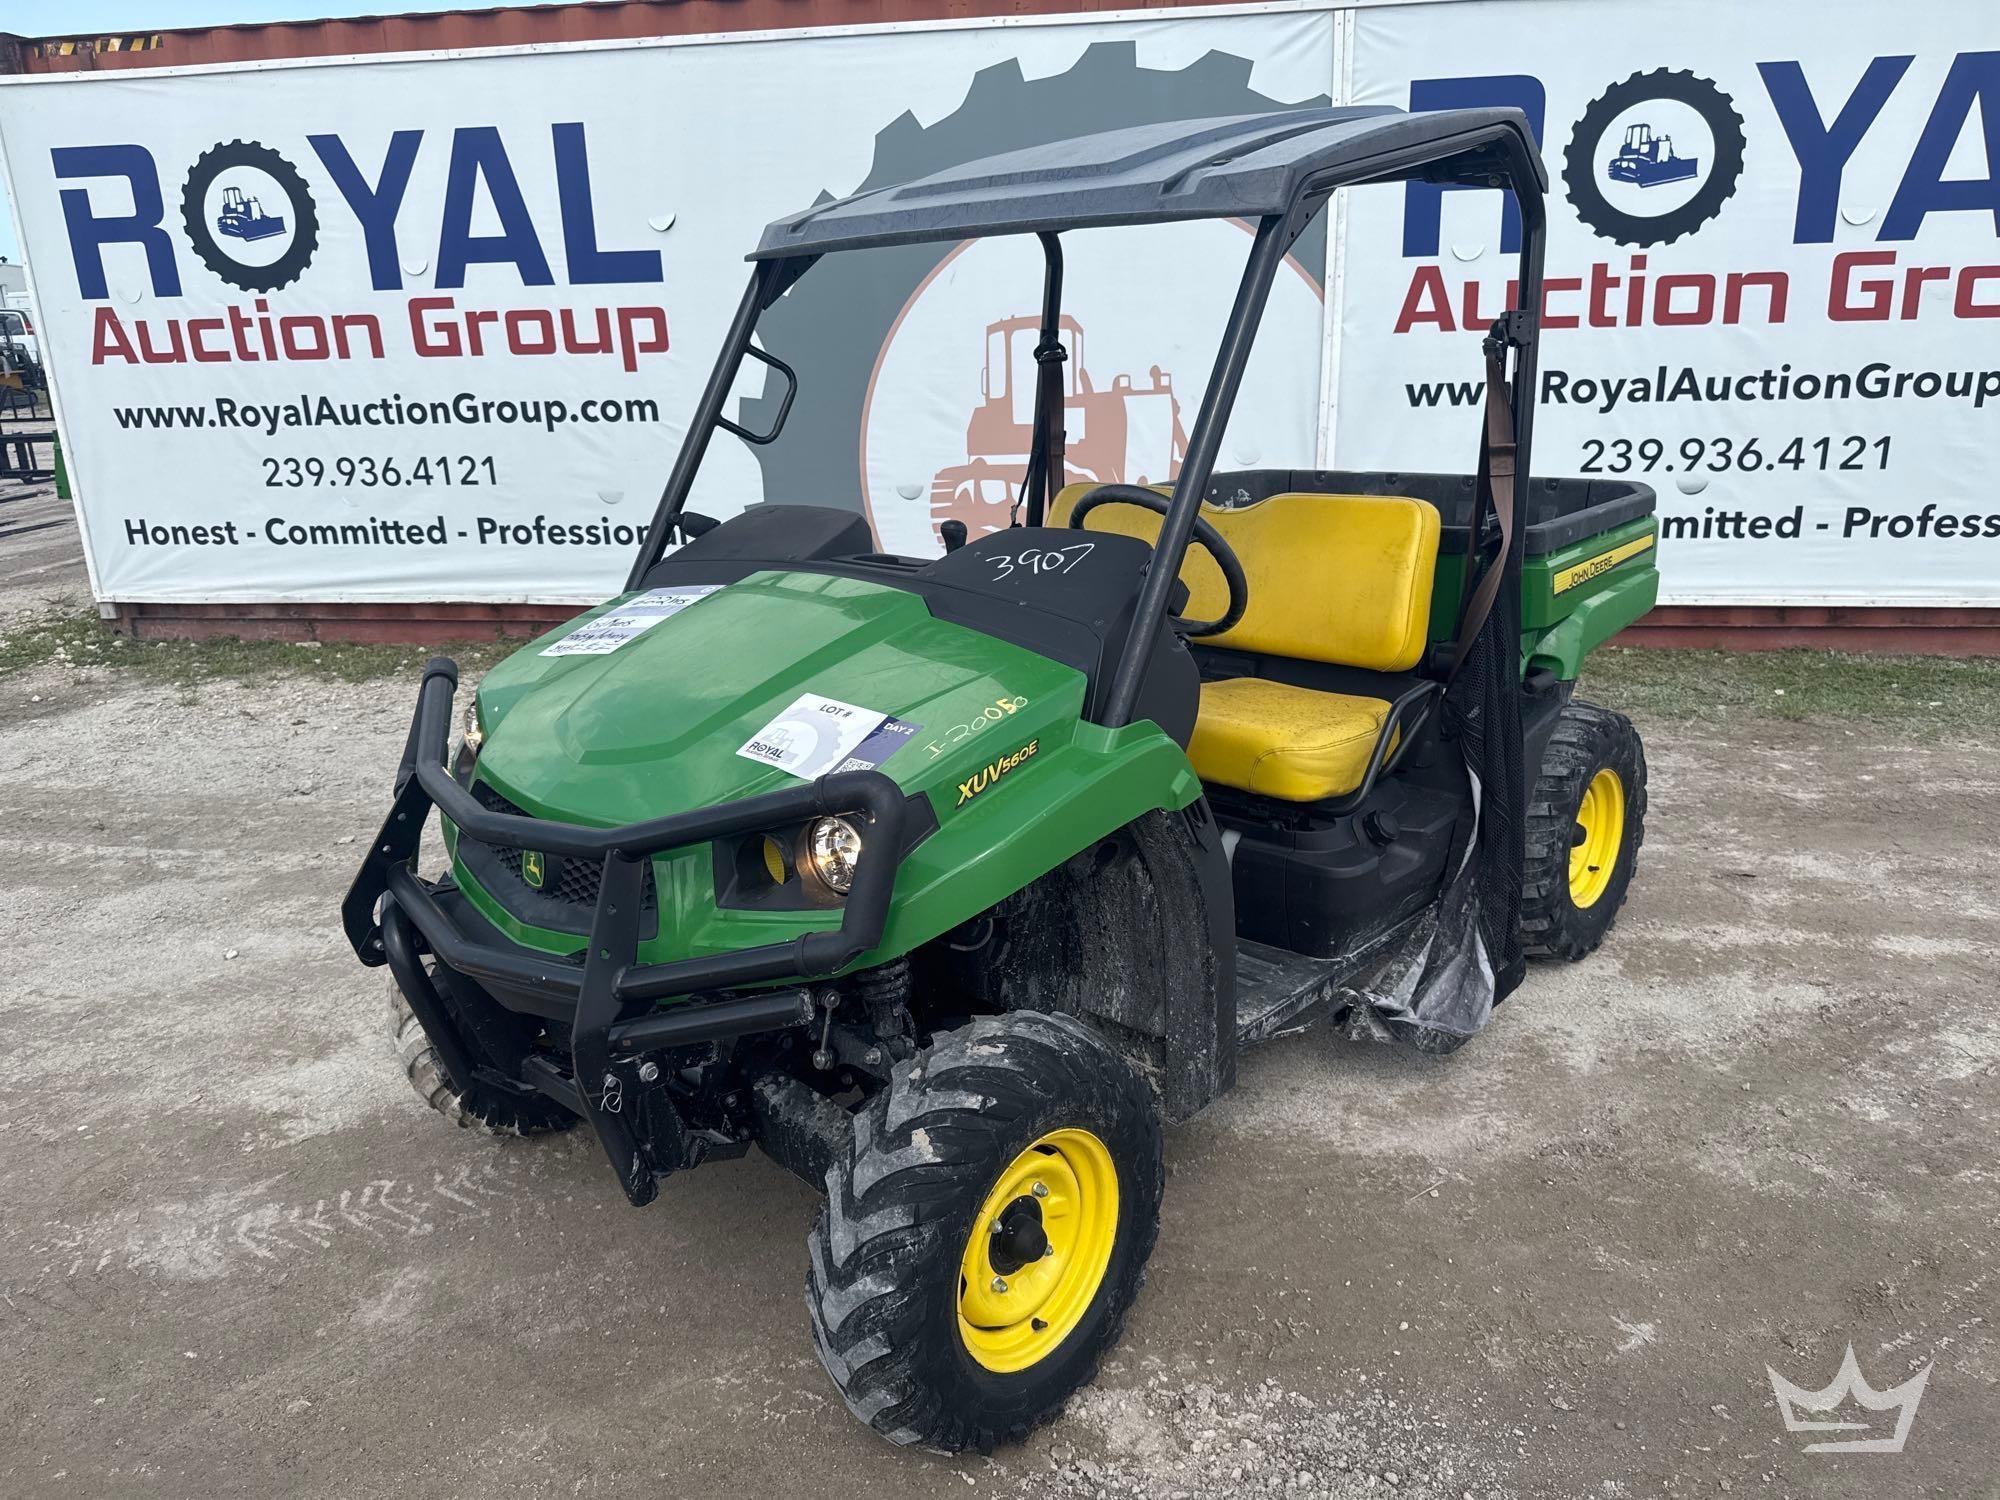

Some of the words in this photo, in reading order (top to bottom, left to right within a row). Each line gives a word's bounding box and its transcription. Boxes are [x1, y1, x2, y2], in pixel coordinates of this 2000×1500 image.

[51, 122, 664, 299] ROYAL
[1394, 254, 1789, 334] Auction
[92, 299, 384, 365] Auction
[408, 297, 670, 372] Group
[113, 392, 660, 436] www.RoyalAuctionGroup.com
[262, 455, 498, 488] 239.936.4121
[1579, 435, 1892, 474] 239.936.4121
[124, 518, 239, 546] Honest
[264, 515, 448, 546] Committed
[1661, 505, 1804, 539] mitted
[985, 543, 1095, 581] 3907
[1568, 568, 1590, 588] JOHN
[1589, 555, 1614, 577] DEERE
[819, 704, 845, 715] LOT
[883, 722, 907, 733] DAY
[748, 741, 785, 759] ROYAL
